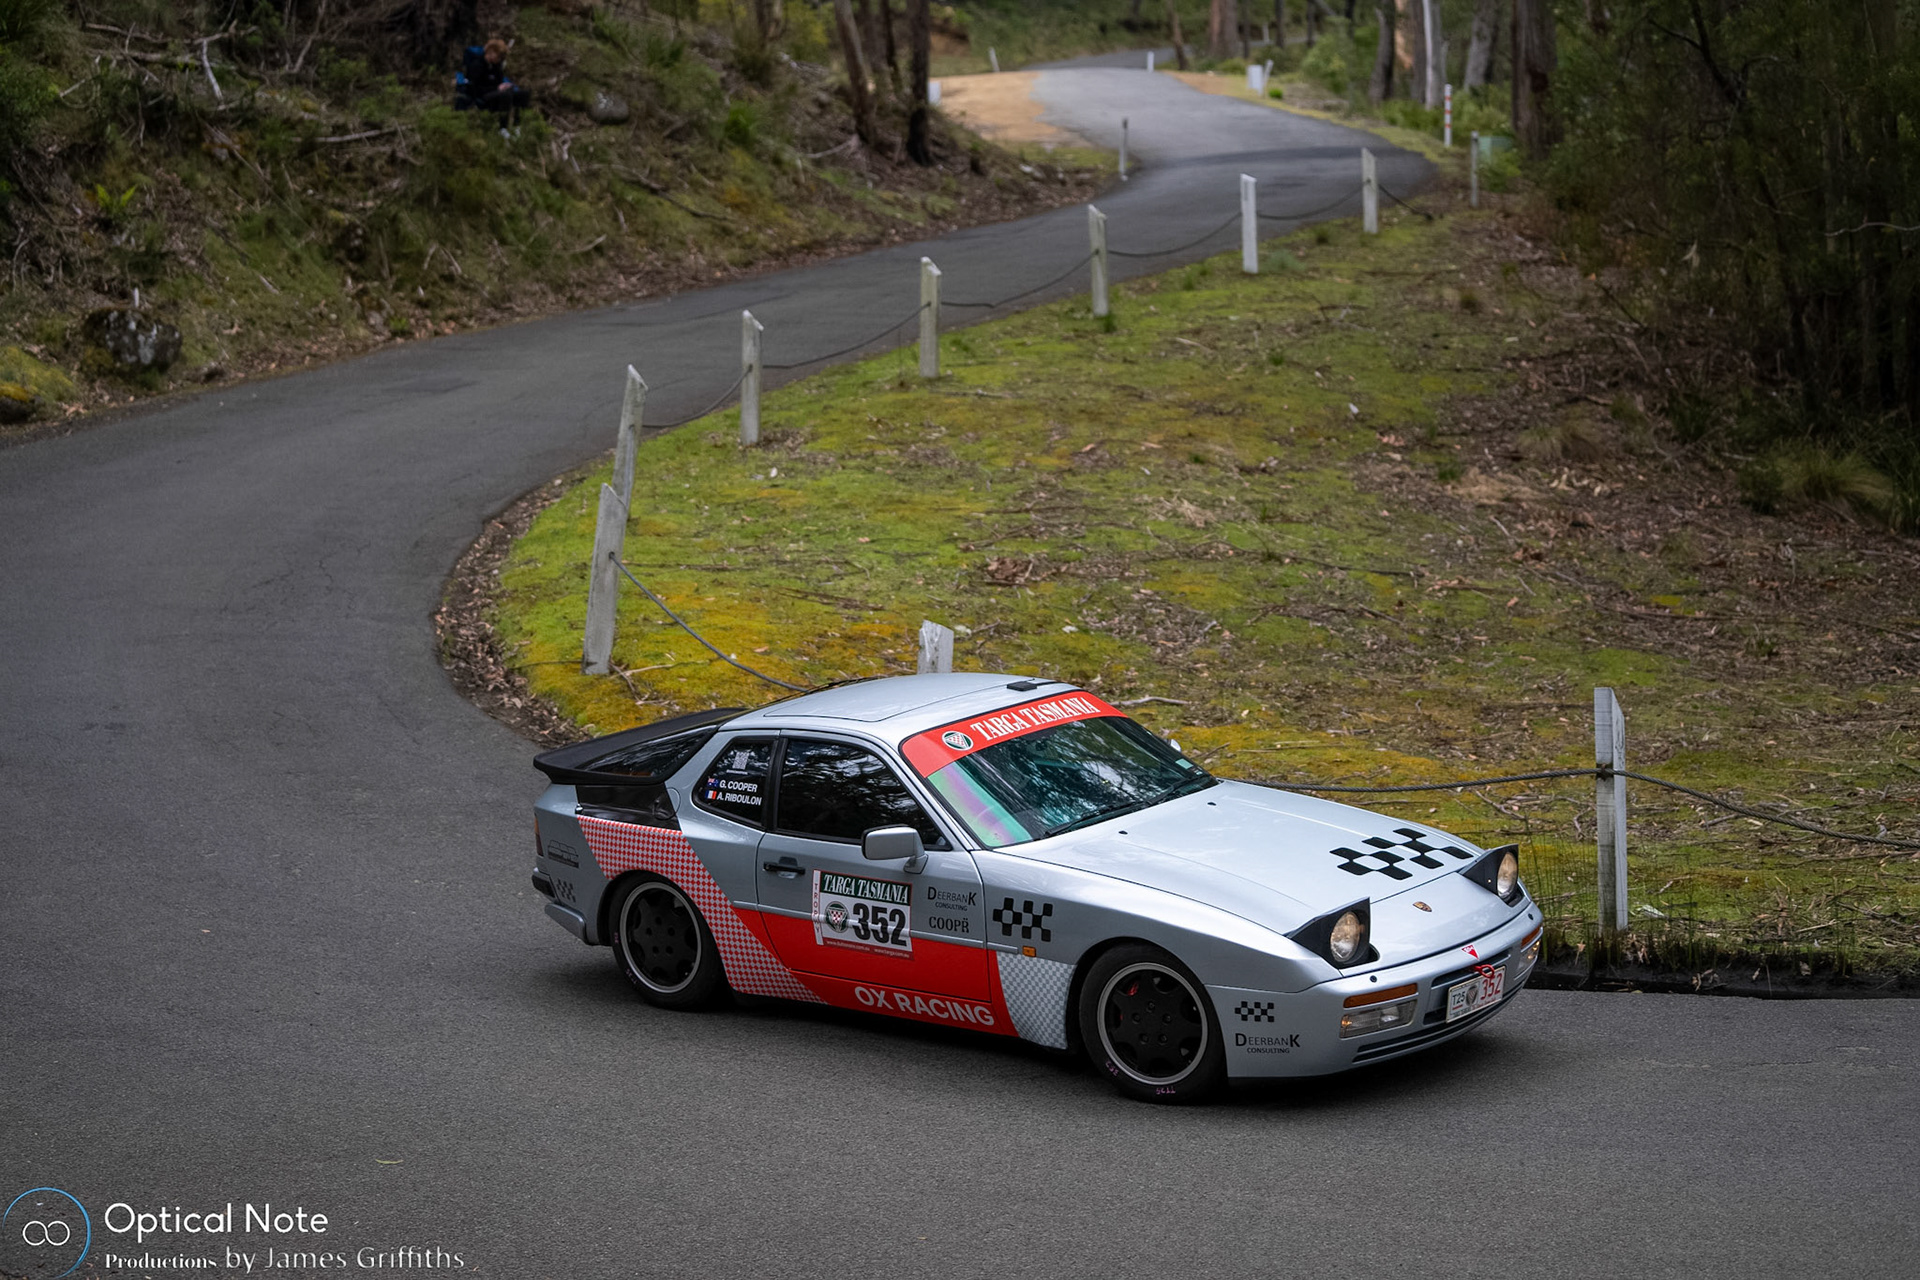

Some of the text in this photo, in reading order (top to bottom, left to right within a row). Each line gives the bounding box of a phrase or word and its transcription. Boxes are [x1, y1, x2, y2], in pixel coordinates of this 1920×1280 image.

[970, 697, 1101, 741] TARGA TASMANIA
[716, 791, 763, 806] A. RIBOULON
[719, 779, 758, 793] G. COOPER
[823, 874, 909, 904] TARGA TASMANIA
[934, 901, 968, 912] CONSULTING
[852, 902, 907, 947] 352
[1452, 972, 1503, 1006] T25 352
[854, 986, 995, 1026] OX RACING
